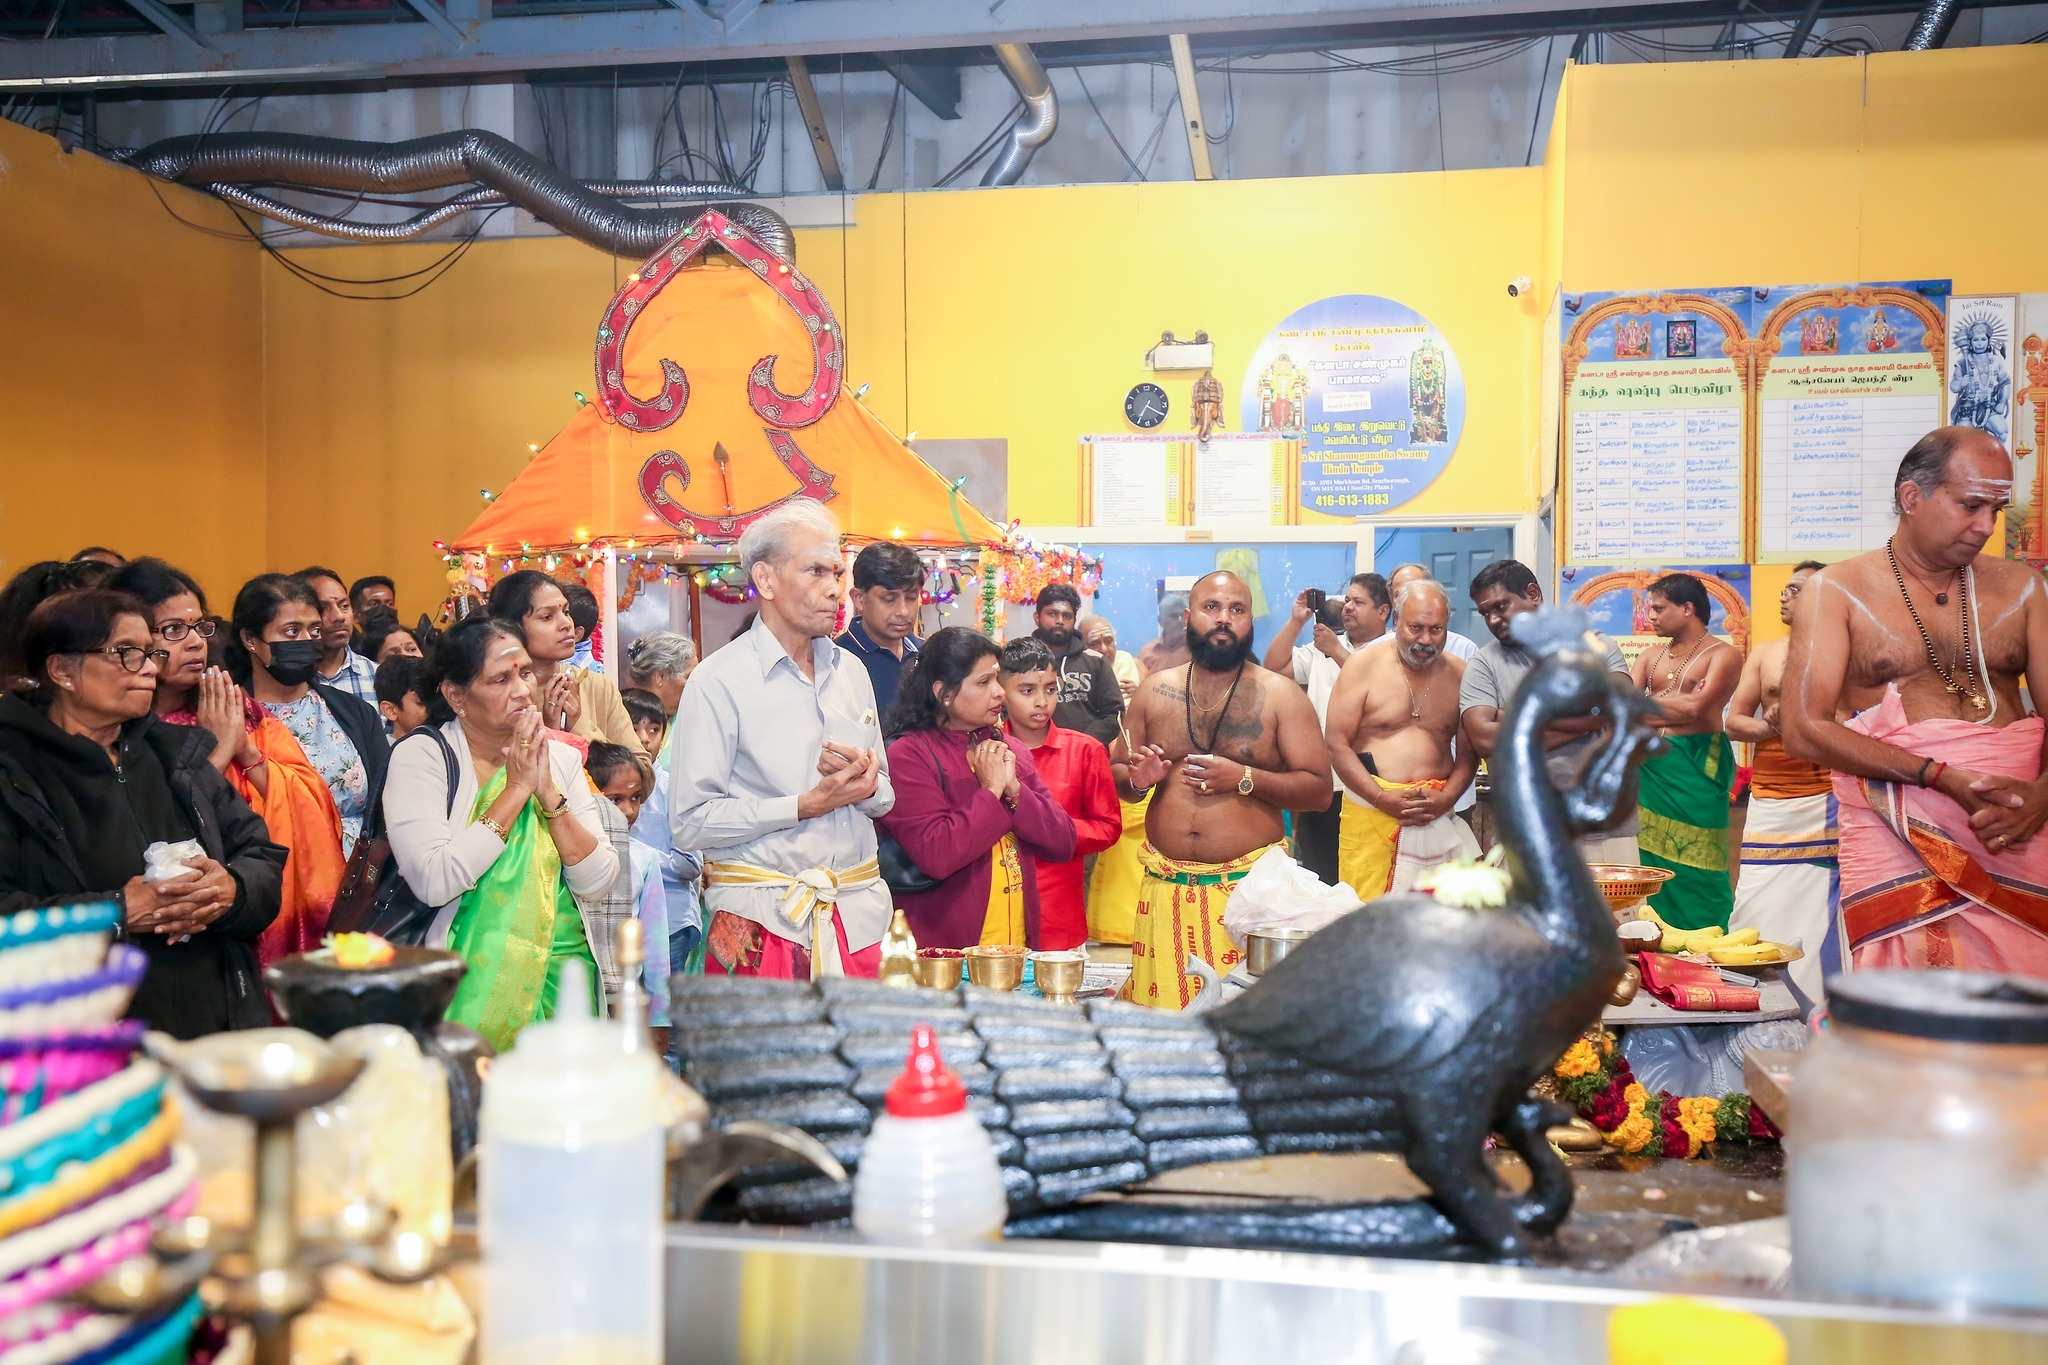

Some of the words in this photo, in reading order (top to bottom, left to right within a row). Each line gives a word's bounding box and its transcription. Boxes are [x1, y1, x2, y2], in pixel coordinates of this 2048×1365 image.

[1986, 300, 2003, 309] Ram
[1669, 382, 1732, 396] பெருவிழா
[1308, 451, 1322, 462] Sri
[1324, 450, 1396, 462] Shanmuganatha
[1397, 448, 1430, 462] Swamy
[1322, 464, 1349, 474] Hindu
[1351, 464, 1384, 476] Temple
[1316, 494, 1389, 506] 416-613-1883
[1056, 672, 1092, 692] OSS
